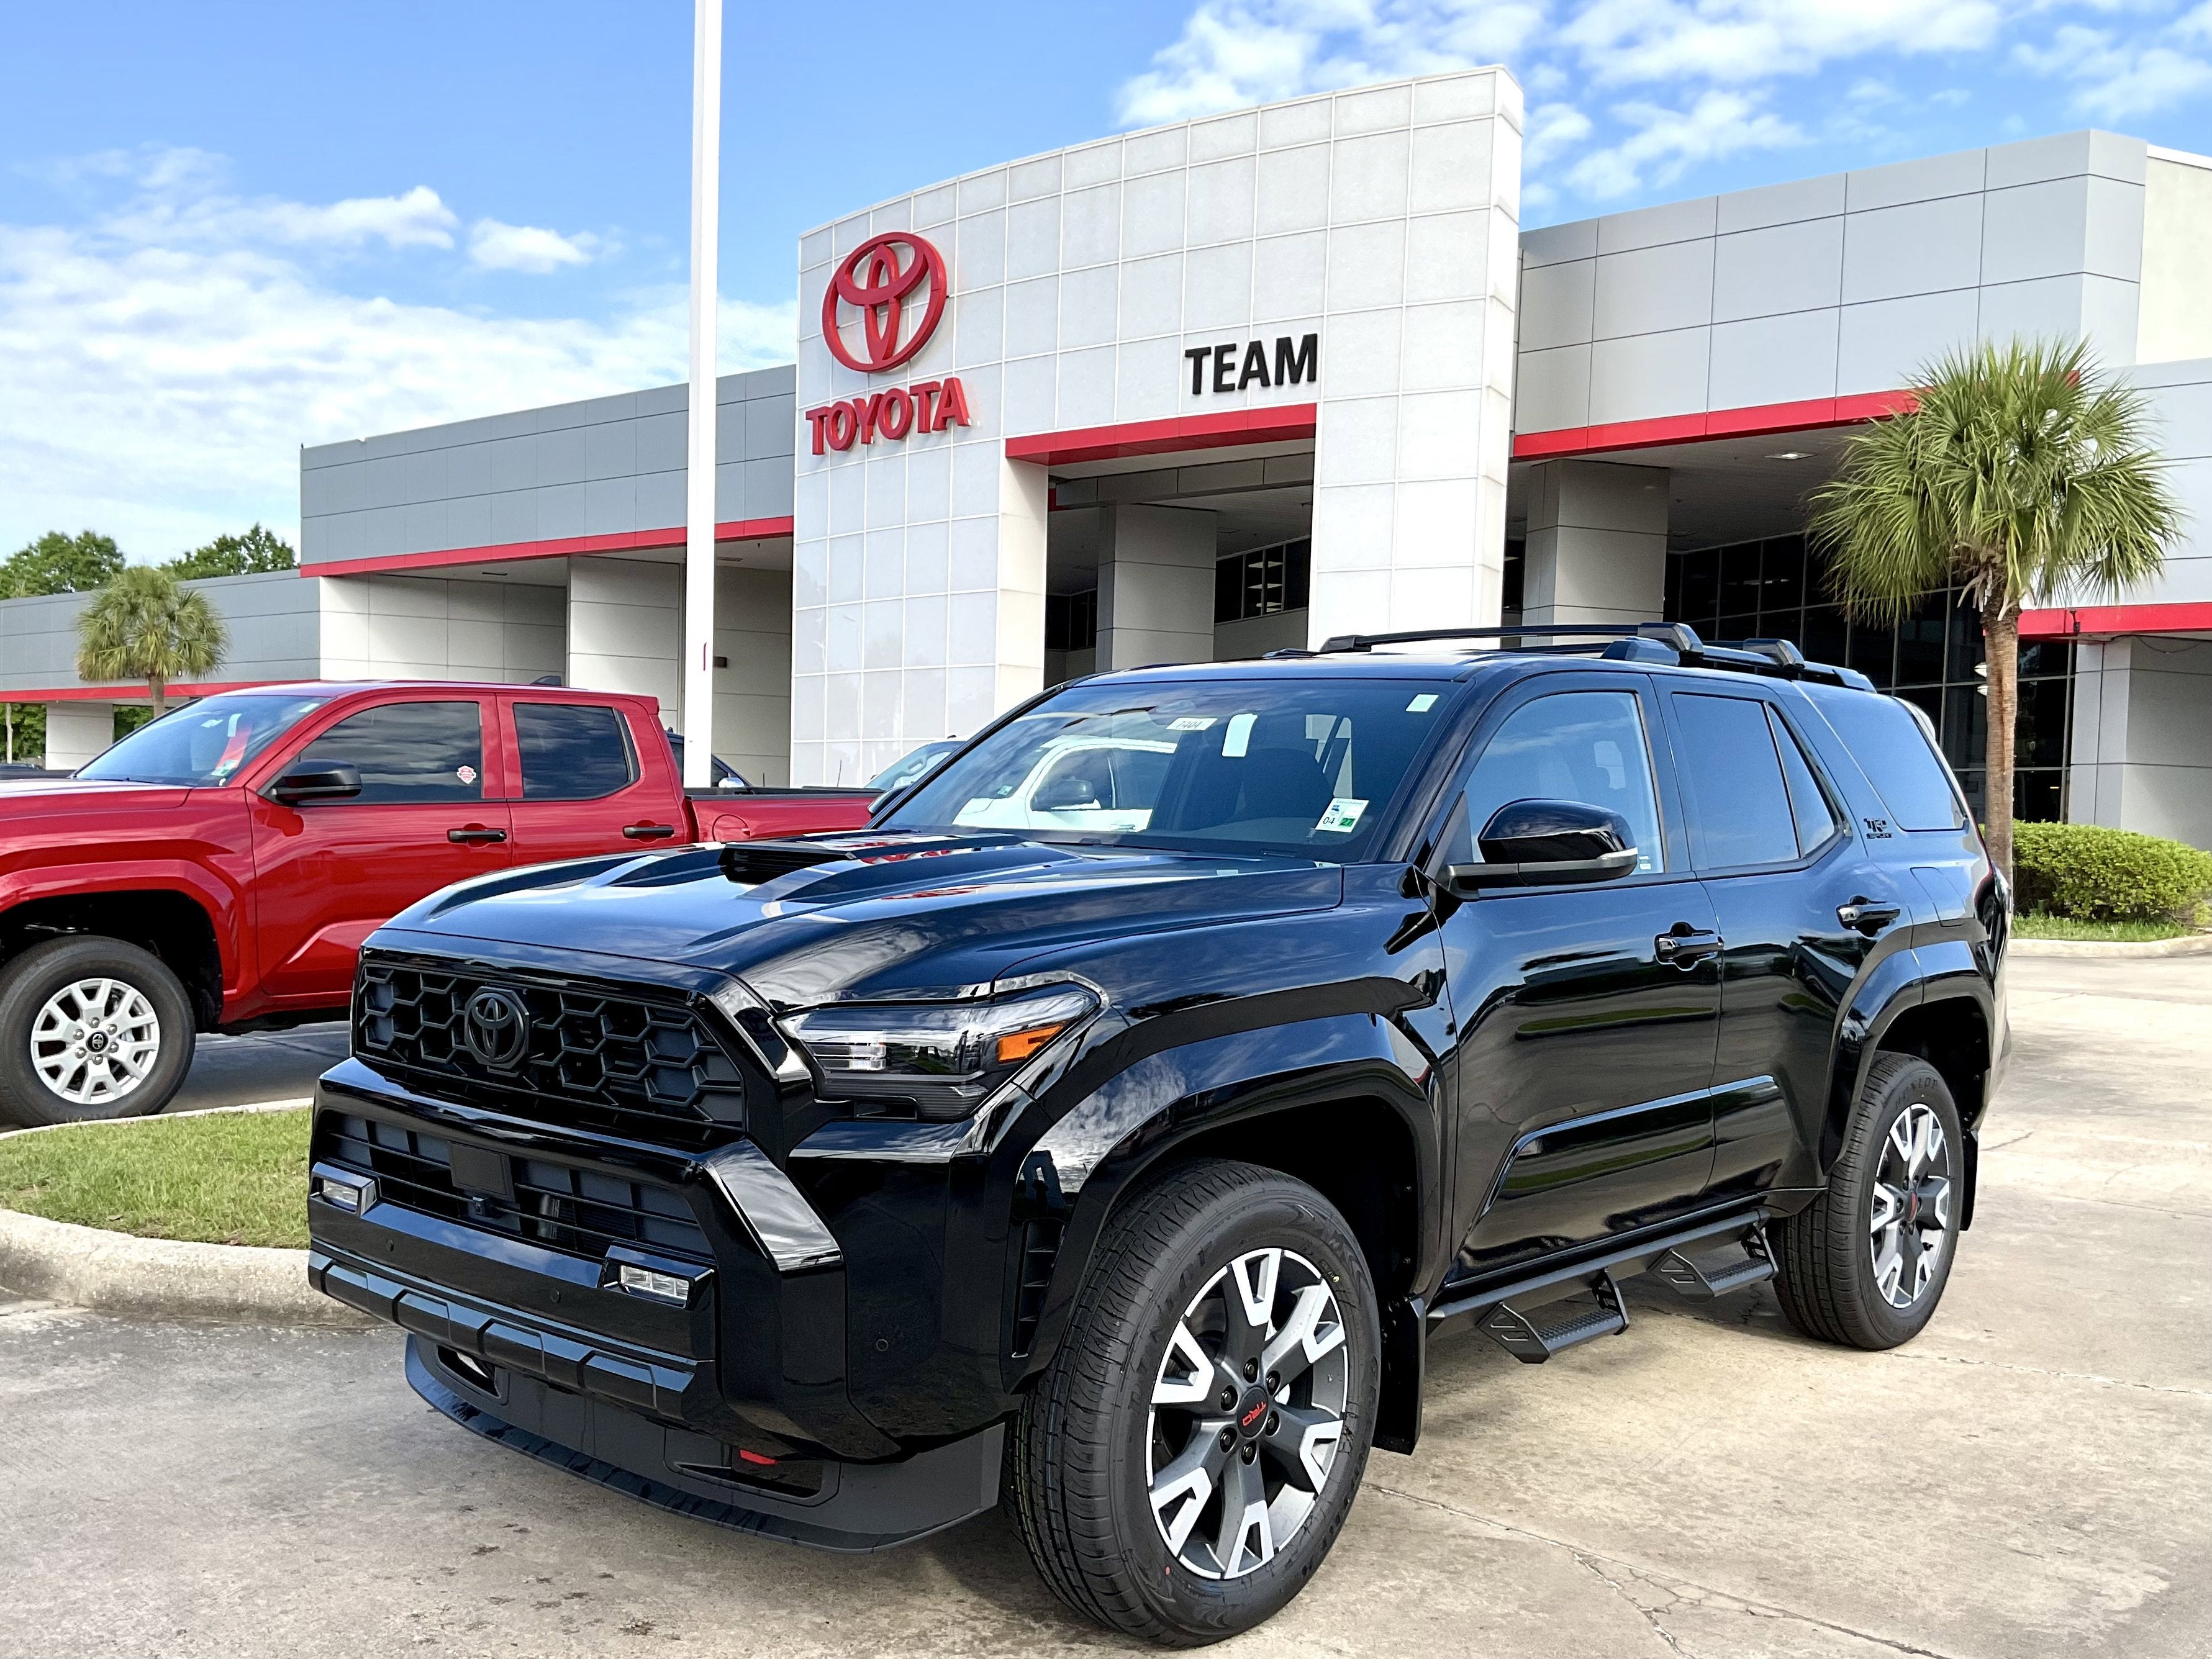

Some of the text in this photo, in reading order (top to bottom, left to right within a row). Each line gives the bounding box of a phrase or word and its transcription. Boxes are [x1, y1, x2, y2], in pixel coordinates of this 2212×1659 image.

[1184, 333, 1318, 395] TEAM
[806, 377, 971, 455] TOYOTA
[1323, 816, 1336, 825] 04
[1339, 817, 1356, 826] 27
[1864, 818, 1887, 832] TRD
[1127, 1241, 1213, 1411] DUNLOP
[1242, 1401, 1267, 1427] TRD
